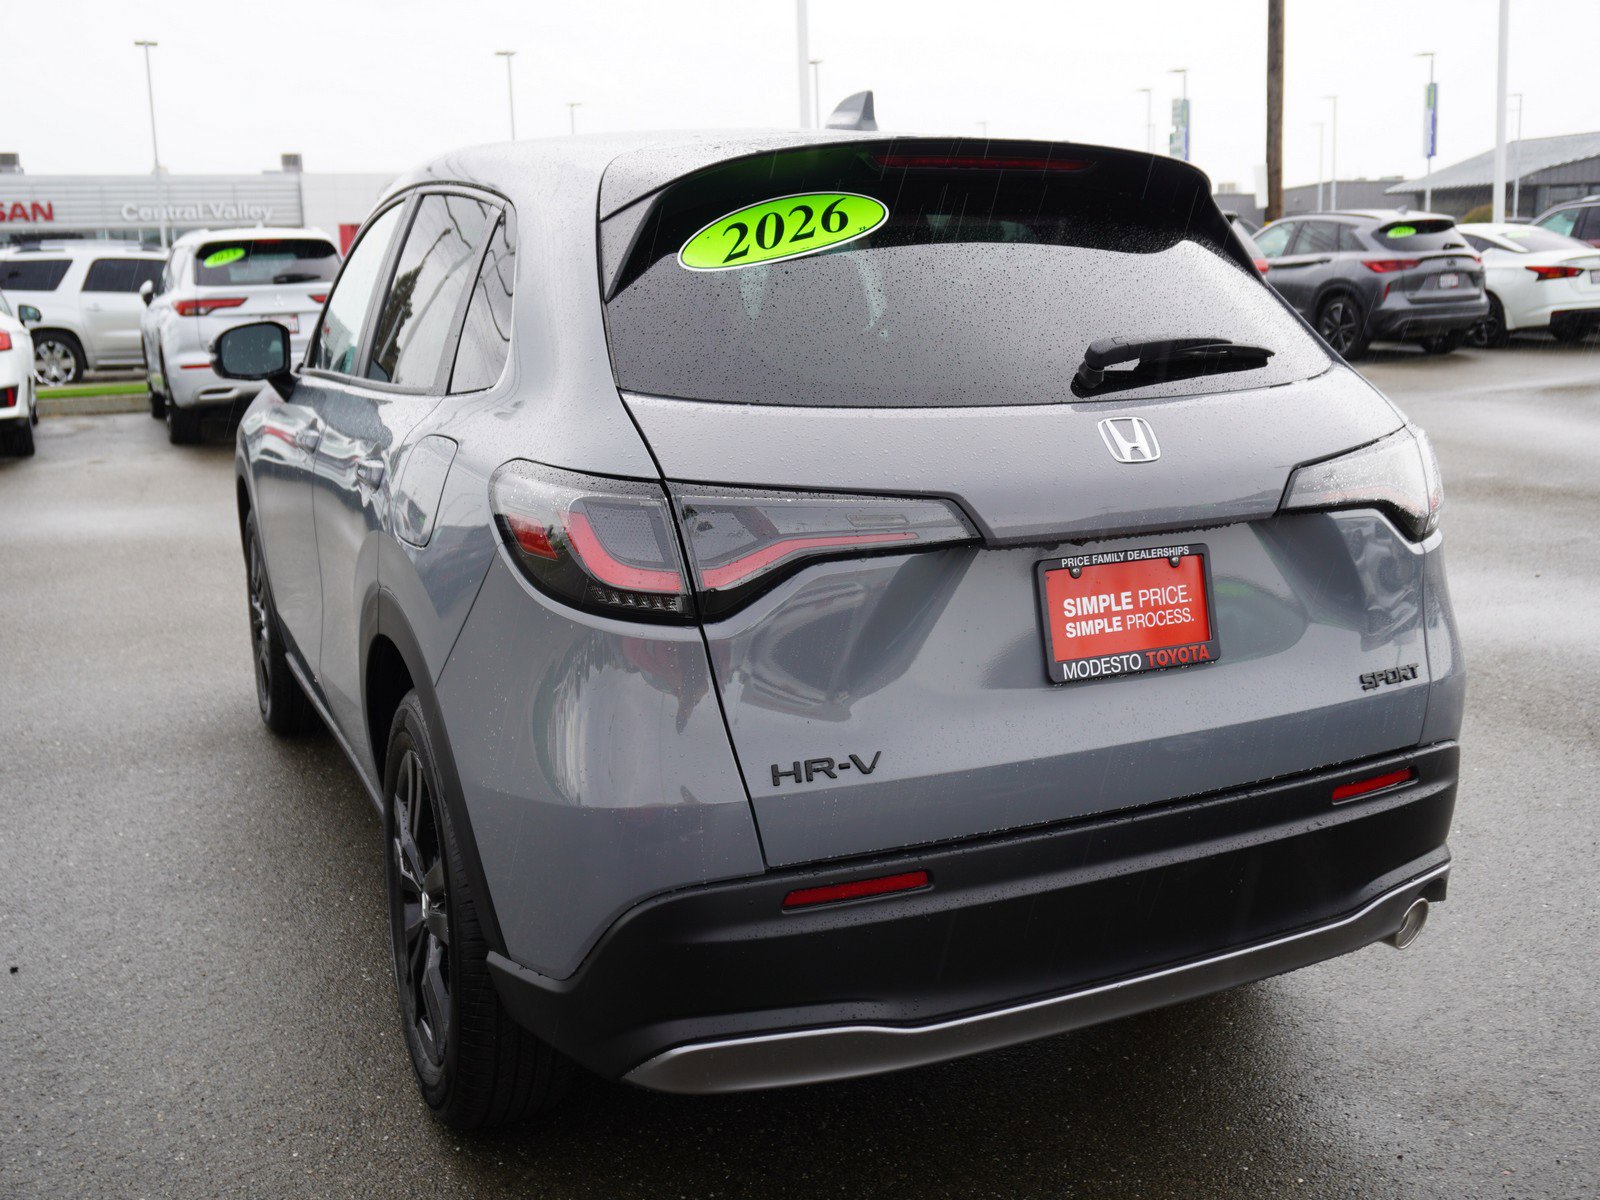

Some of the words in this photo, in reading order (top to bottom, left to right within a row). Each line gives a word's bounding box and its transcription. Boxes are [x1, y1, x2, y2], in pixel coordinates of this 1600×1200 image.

[120, 202, 203, 221] Central
[208, 201, 274, 222] Valley
[722, 197, 849, 263] 2026
[1061, 556, 1090, 568] PRICE
[1092, 552, 1125, 564] FAMILY
[1127, 546, 1190, 559] DEALERSHIPS
[1063, 591, 1133, 617] SIMPLE
[1138, 584, 1193, 608] PRICE.
[1065, 616, 1123, 639] SIMPLE
[1126, 607, 1195, 630] PROCESS.
[1062, 653, 1142, 679] MODESTO
[1145, 644, 1210, 667] TOYOTA
[1359, 663, 1419, 691] SPORT
[770, 751, 881, 786] HR-V
